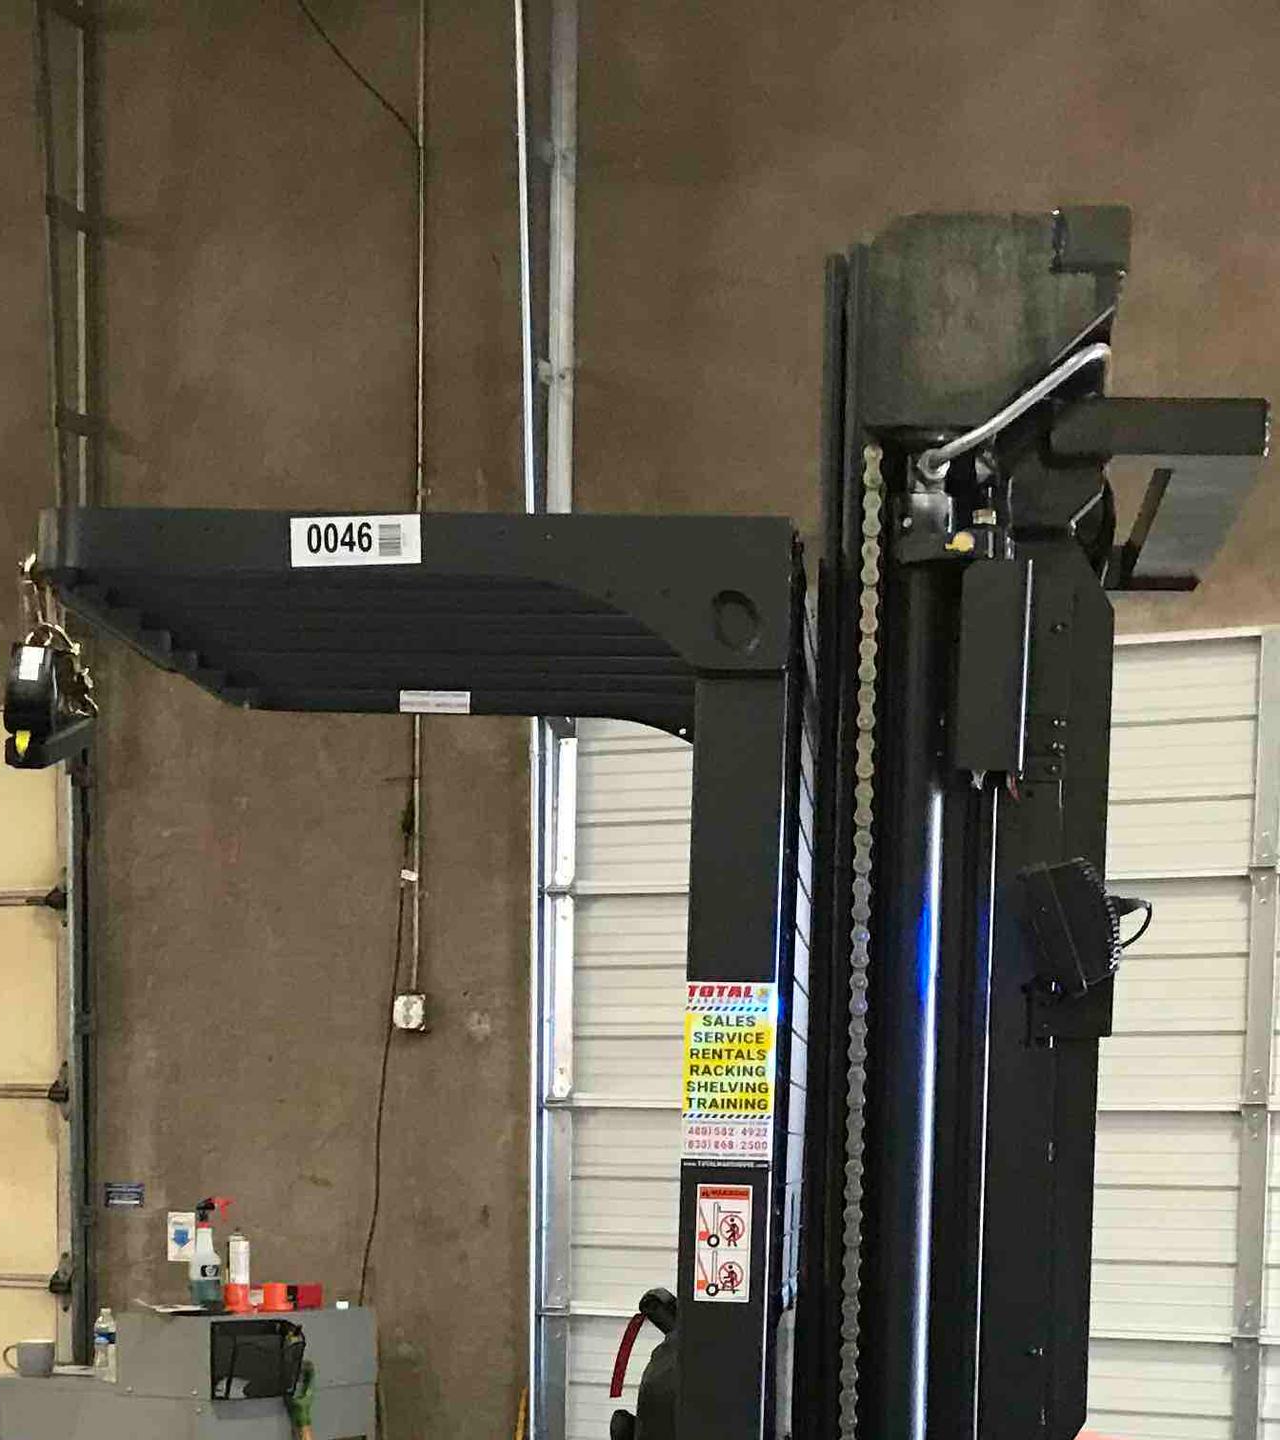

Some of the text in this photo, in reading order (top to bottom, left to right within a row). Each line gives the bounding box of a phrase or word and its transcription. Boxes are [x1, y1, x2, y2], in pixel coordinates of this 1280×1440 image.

[306, 522, 373, 554] 0046
[688, 985, 753, 998] TOTAL
[702, 1014, 756, 1028] SALES
[693, 1031, 765, 1044] SERVICE
[689, 1048, 767, 1061] RENTALS
[689, 1064, 766, 1077] RACKING
[686, 1080, 769, 1094] SHELVING
[686, 1096, 769, 1110] TRAINING
